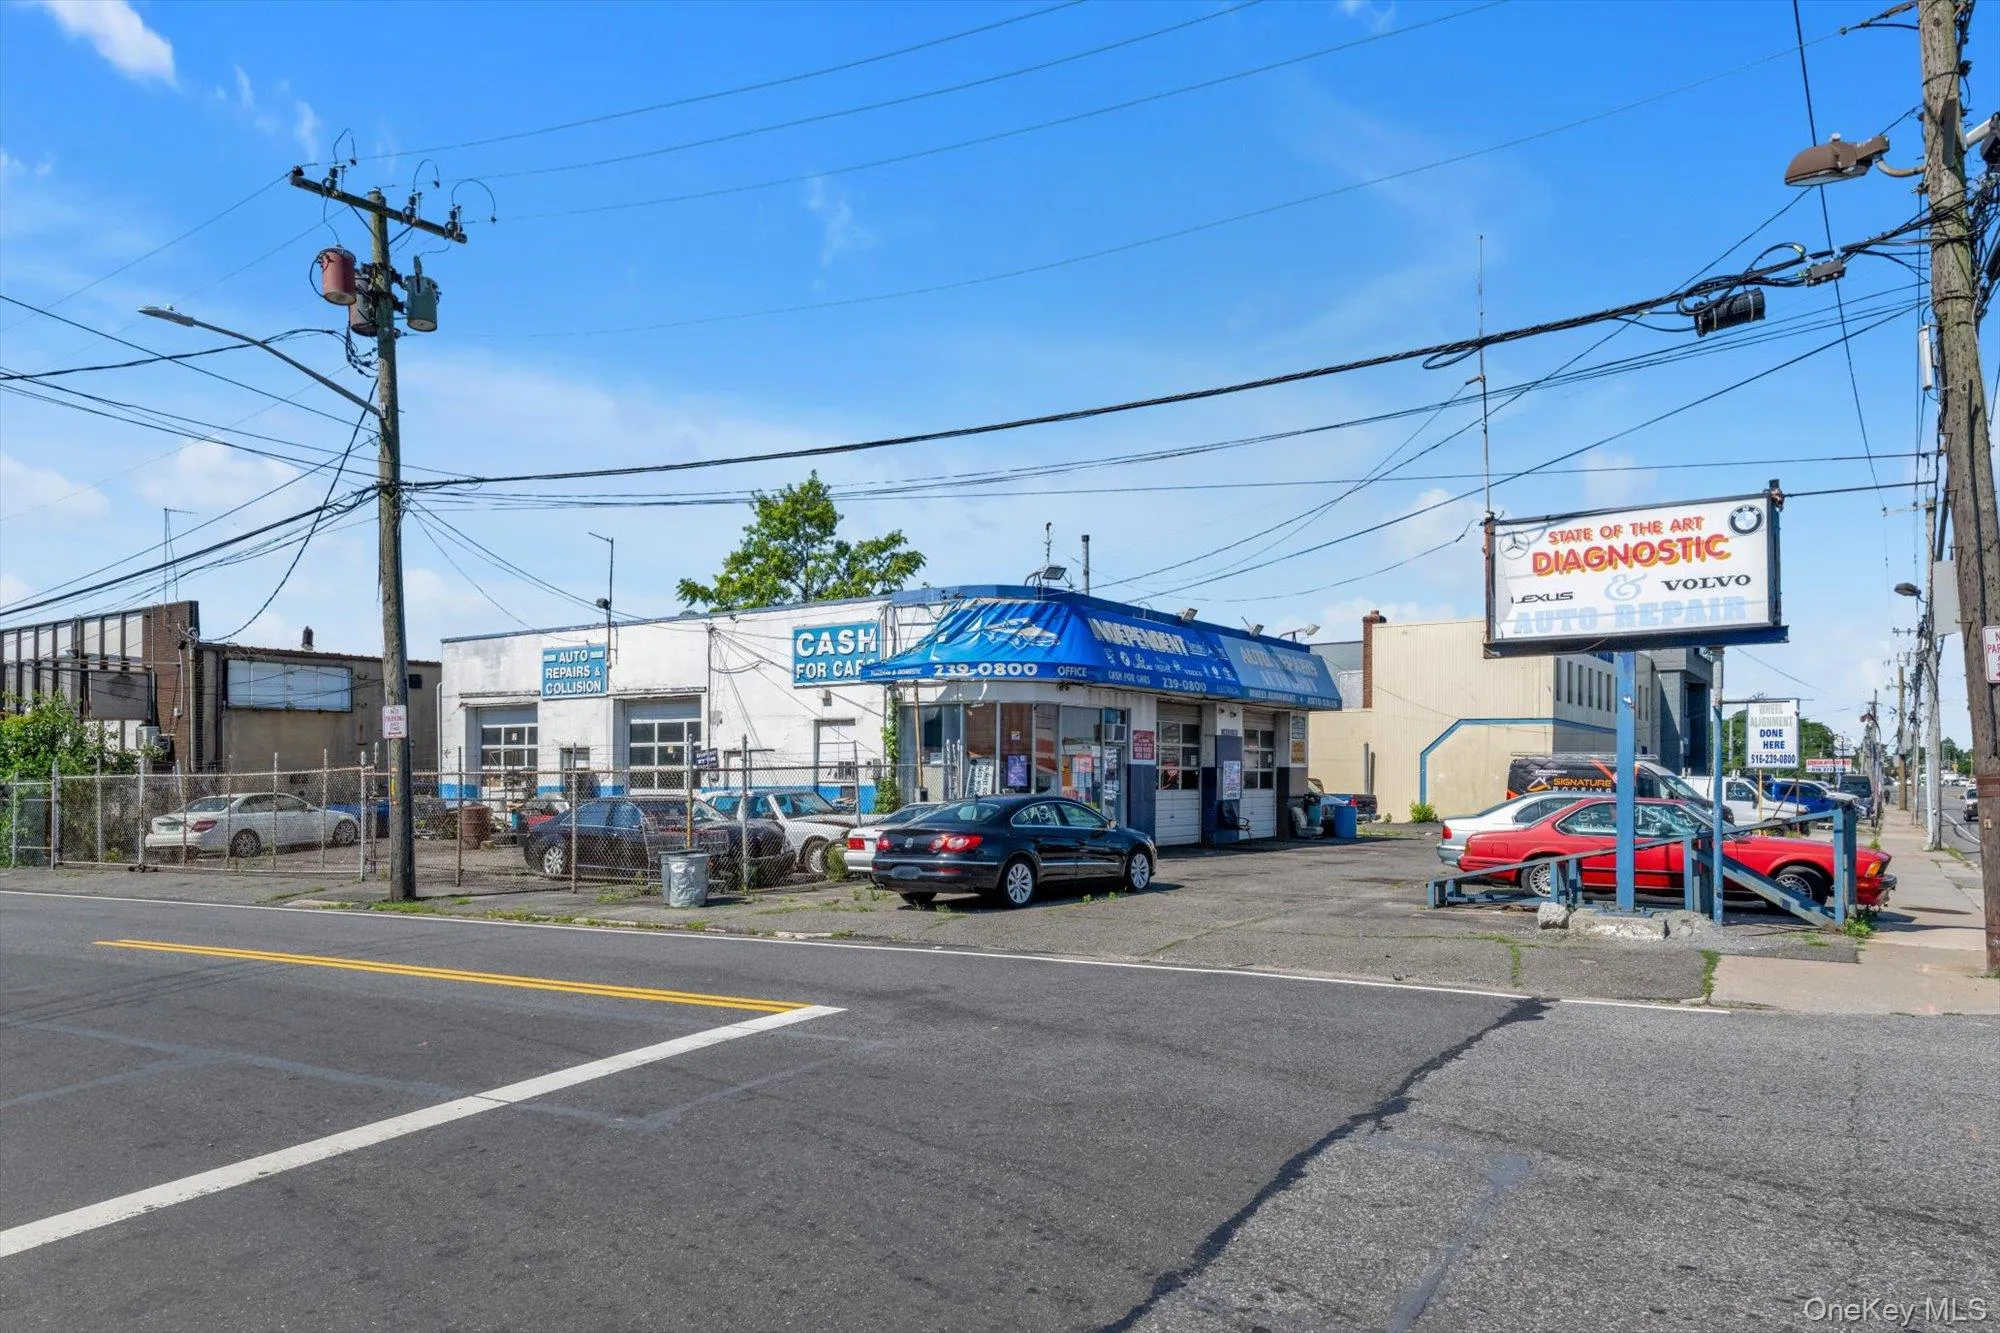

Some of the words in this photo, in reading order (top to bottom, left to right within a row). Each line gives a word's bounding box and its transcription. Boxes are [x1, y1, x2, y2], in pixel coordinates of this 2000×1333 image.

[1548, 527, 1593, 545] STATE
[1599, 524, 1624, 540] OF
[1629, 520, 1664, 537] THE
[1669, 515, 1705, 533] ART
[1531, 533, 1732, 577] DIAGNOSTIC
[1603, 573, 1648, 602] &
[1661, 574, 1752, 591] VOLVO
[1510, 591, 1574, 605] LEXUS
[1513, 606, 1598, 635] AUTO
[1614, 596, 1747, 629] REPAIR
[796, 628, 877, 657] CASH
[558, 649, 588, 664] AUTO
[545, 664, 591, 680] REPAIRS
[594, 666, 601, 676] &
[796, 662, 827, 679] FOR
[933, 662, 1039, 677] 239-0800
[1057, 665, 1088, 678] OFFICE
[1123, 672, 1135, 682] FOR
[545, 680, 601, 695] COLLISION
[1162, 677, 1207, 693] 239-0800
[1759, 703, 1784, 715] WHEEL
[1750, 715, 1793, 728] ALIGNMENT
[1759, 729, 1784, 738] DONE
[1763, 740, 1786, 750] HERE
[1750, 753, 1796, 764] 516-239-0800
[1553, 778, 1612, 787] SIGNATURE
